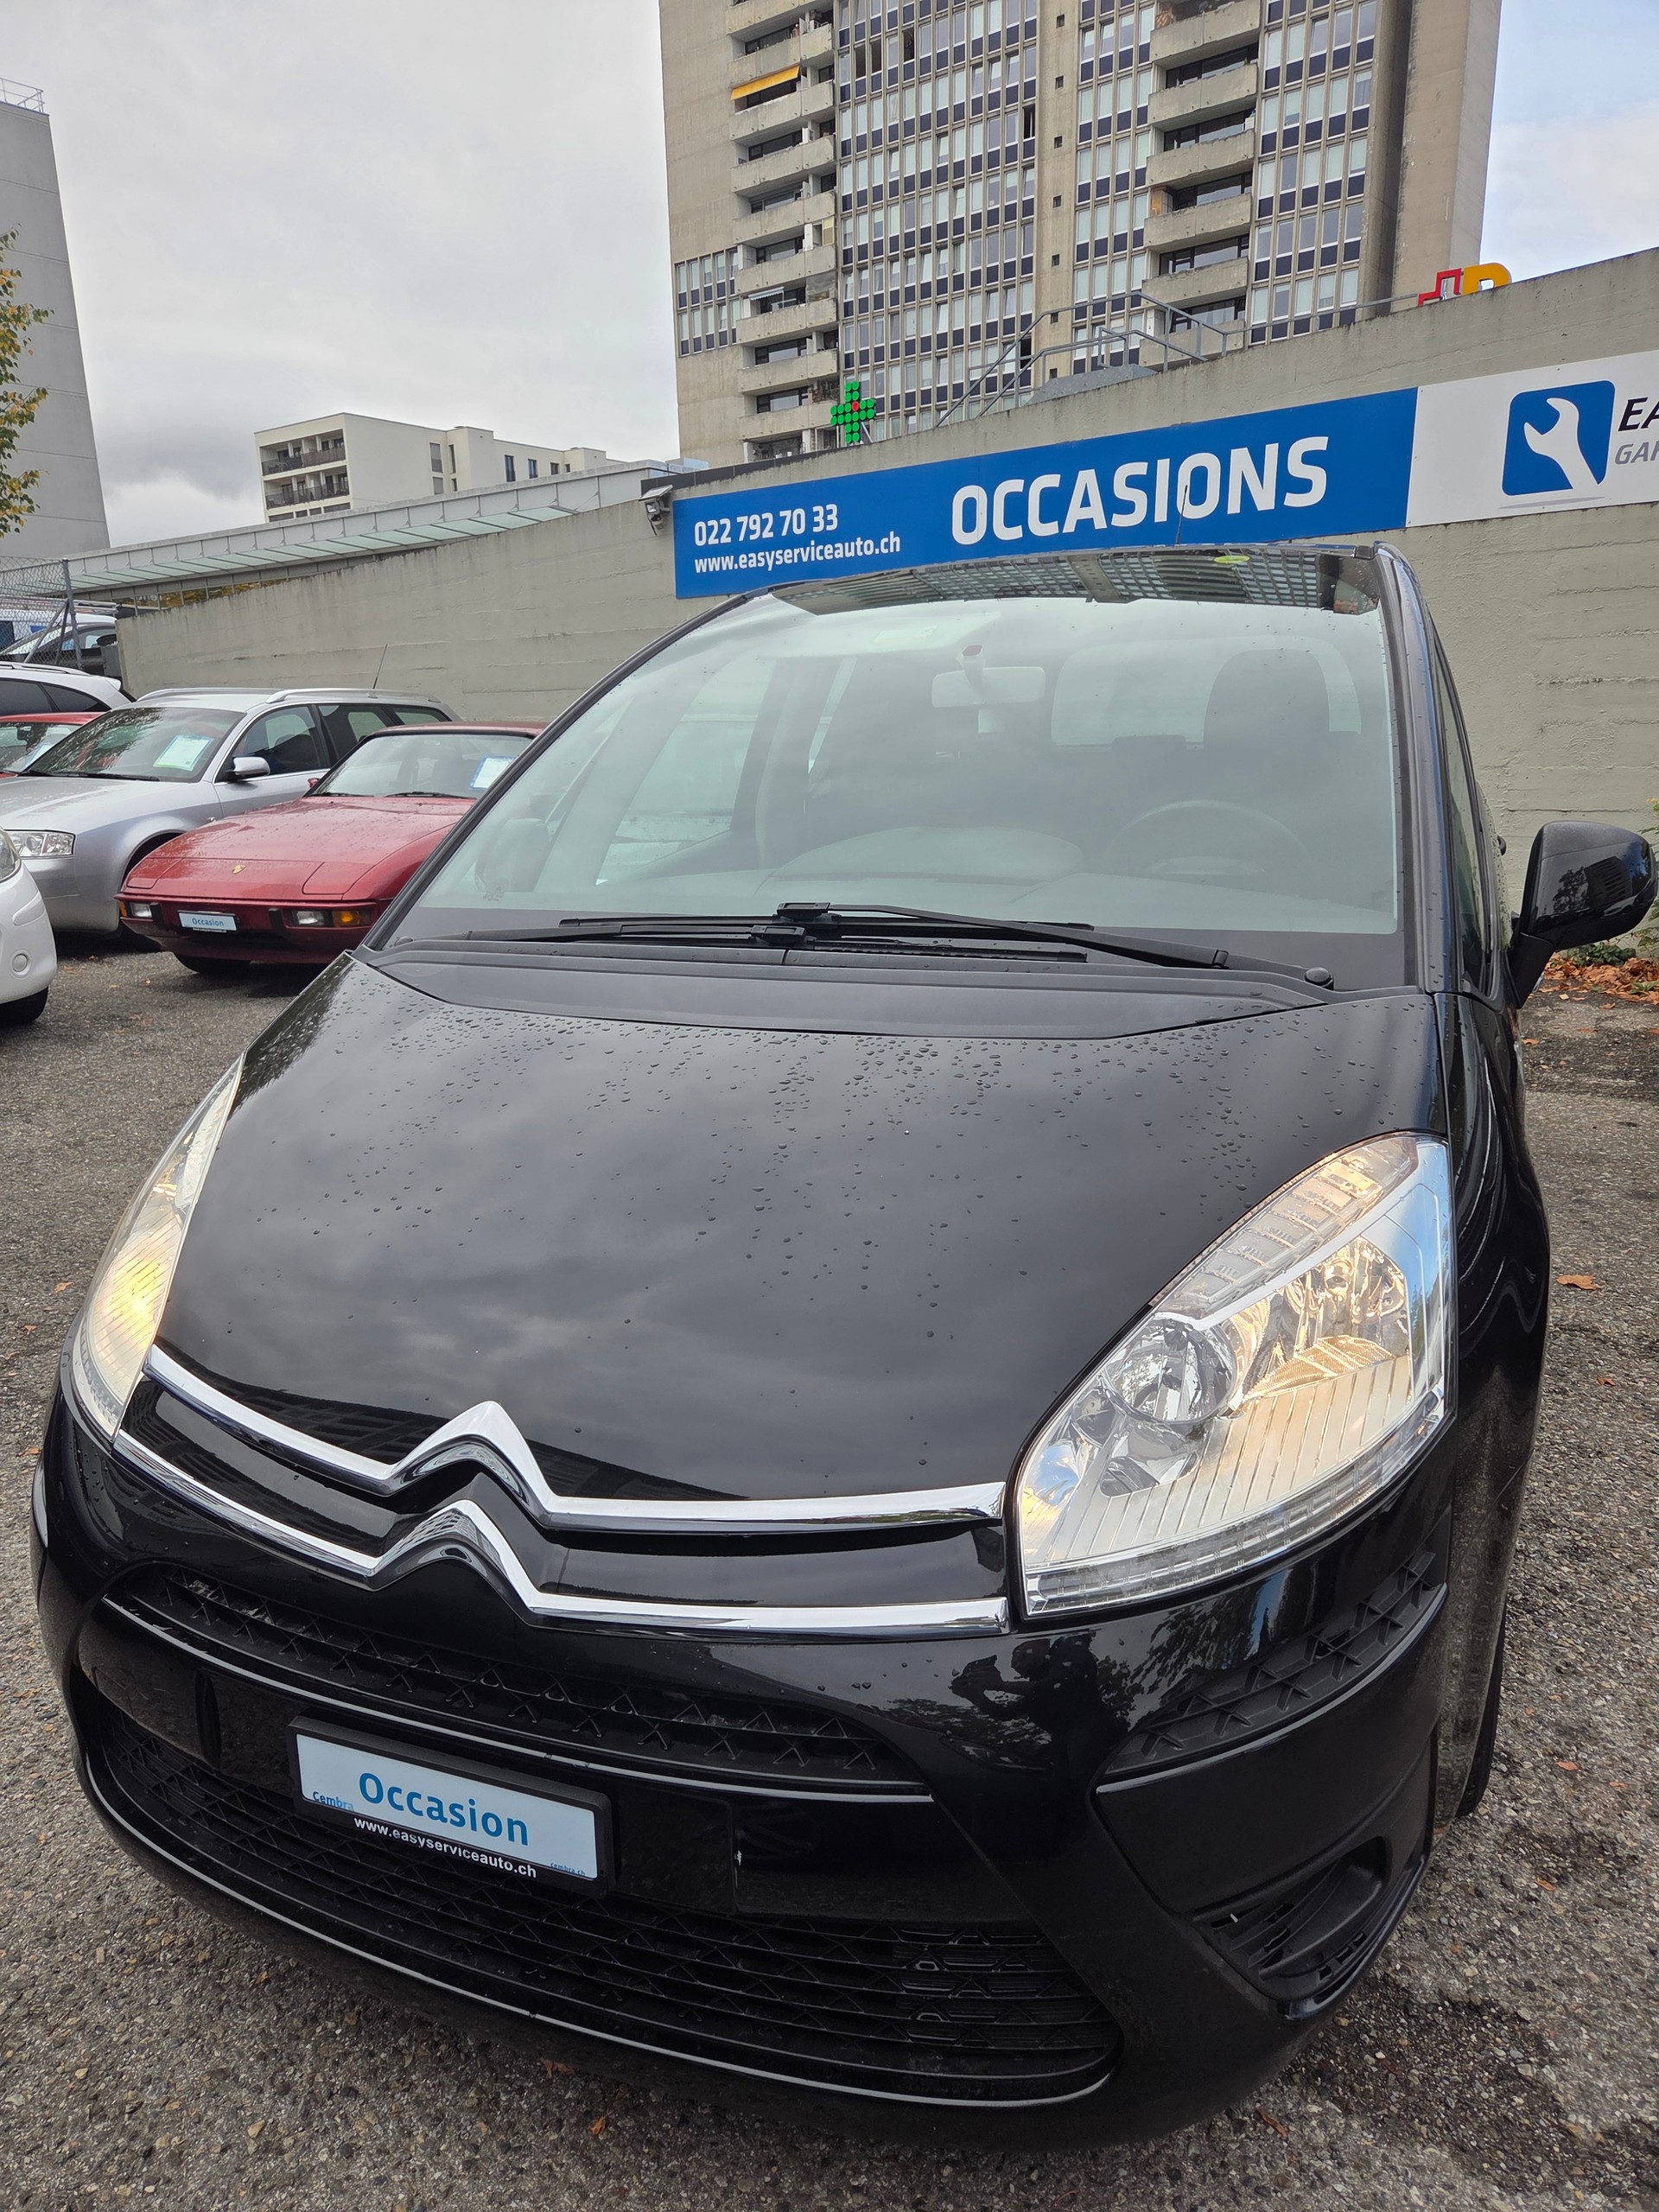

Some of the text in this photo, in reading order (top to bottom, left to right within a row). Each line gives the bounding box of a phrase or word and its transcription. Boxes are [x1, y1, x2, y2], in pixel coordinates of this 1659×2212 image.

[951, 436, 1328, 545] OCCASIONS
[694, 504, 838, 546] 022 792 70 33
[695, 531, 900, 573] www.easyserviceauto.ch
[192, 918, 224, 926] Occasion
[313, 1791, 354, 1812] Cembra
[359, 1772, 529, 1846] Occasion
[354, 1817, 537, 1878] www.easyserviceauto.ch
